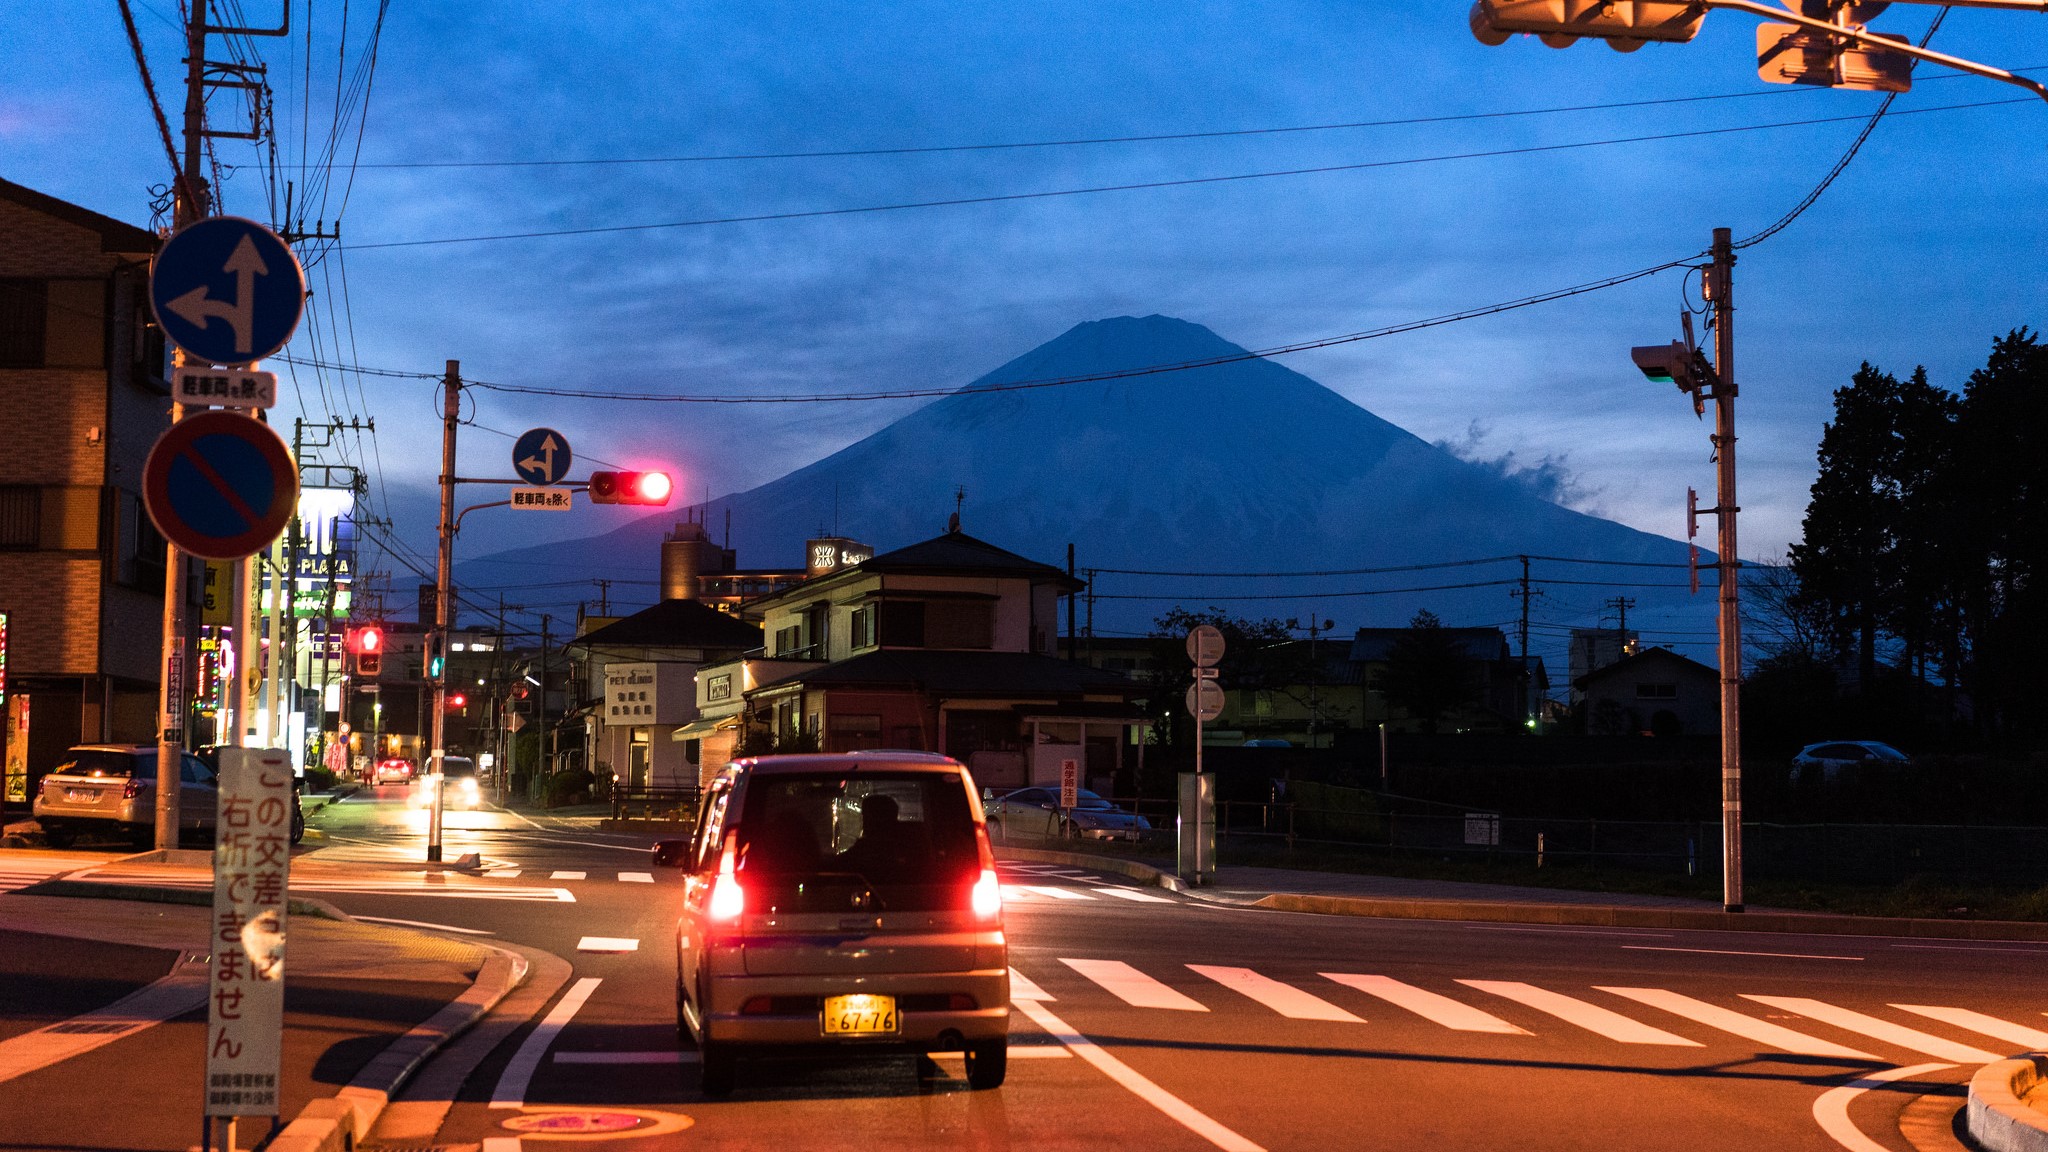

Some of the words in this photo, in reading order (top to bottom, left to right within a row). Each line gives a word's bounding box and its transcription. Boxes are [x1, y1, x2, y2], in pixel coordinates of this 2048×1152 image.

[183, 376, 267, 399] 軽車両を除く
[514, 492, 568, 507] 軽車両を除く
[1063, 760, 1075, 806] 通学路注意
[211, 793, 253, 1061] 右折できません
[840, 1011, 894, 1030] 67-76
